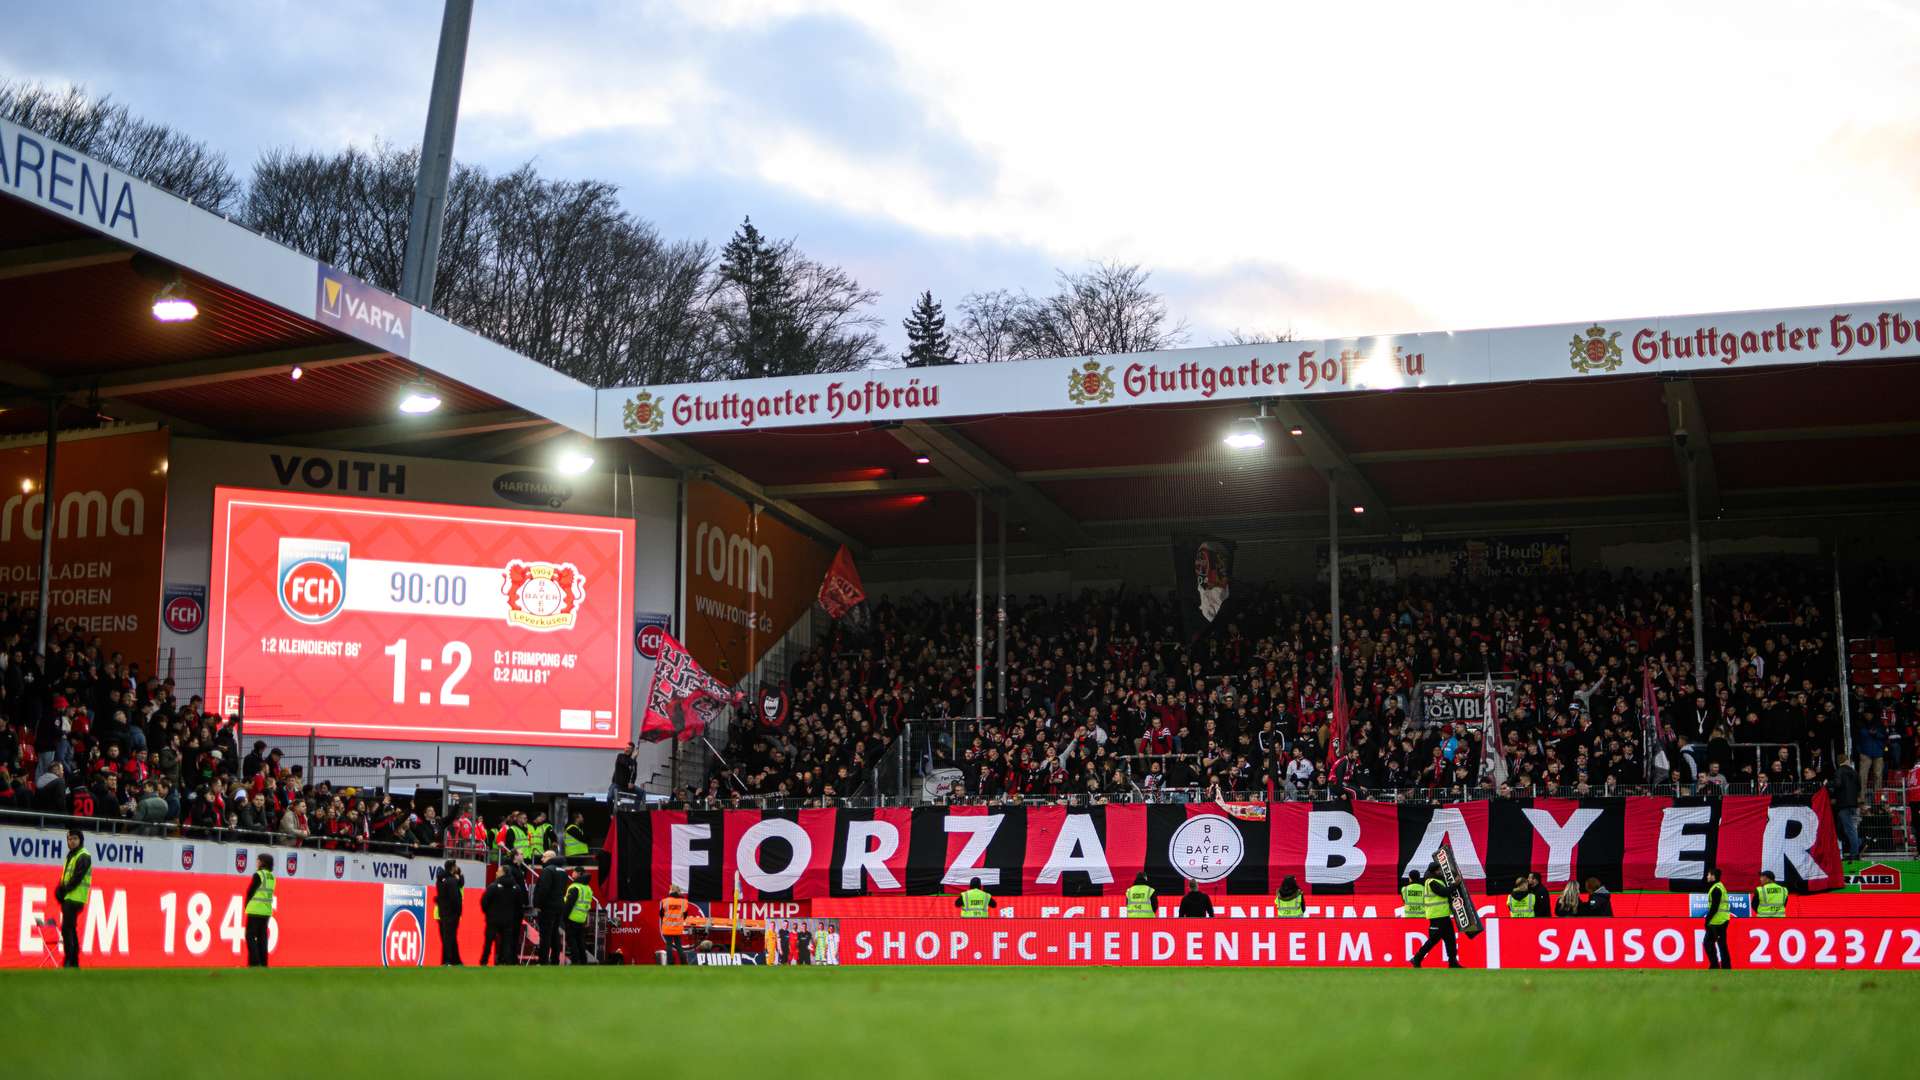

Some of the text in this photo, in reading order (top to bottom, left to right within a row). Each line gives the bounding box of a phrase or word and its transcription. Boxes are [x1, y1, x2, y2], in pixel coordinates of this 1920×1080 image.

[345, 293, 405, 339] VARTA
[1632, 321, 1822, 365] Stuttgarter
[1123, 358, 1290, 398] Stuttgarter
[672, 379, 940, 427] Stuttgarter Hofbräu
[270, 454, 406, 494] VOITH
[292, 577, 334, 604] FCH
[391, 571, 467, 606] 90:00
[171, 607, 197, 624] FCH
[514, 614, 568, 626] Leverkusen
[261, 637, 362, 657] 1:2 KLEINDIENST 86'
[494, 649, 577, 669] 0:1 FRIMPONG 45'
[384, 638, 472, 706] 1:2
[493, 667, 551, 684] 0:2 ADLI 81'
[454, 756, 509, 776] PUMA
[74, 799, 94, 816] 20
[9, 837, 62, 859] VOITH
[96, 843, 143, 864] VOITH
[670, 813, 1115, 894] FORZA
[1186, 845, 1229, 855] BAYER
[1201, 825, 1211, 873] BAYER
[1305, 806, 1830, 885] BAYER
[372, 861, 407, 880] VOITH
[752, 903, 799, 918] MHP
[611, 927, 642, 935] COMPANY
[390, 930, 417, 961] FCH
[697, 952, 742, 966] PUMA
